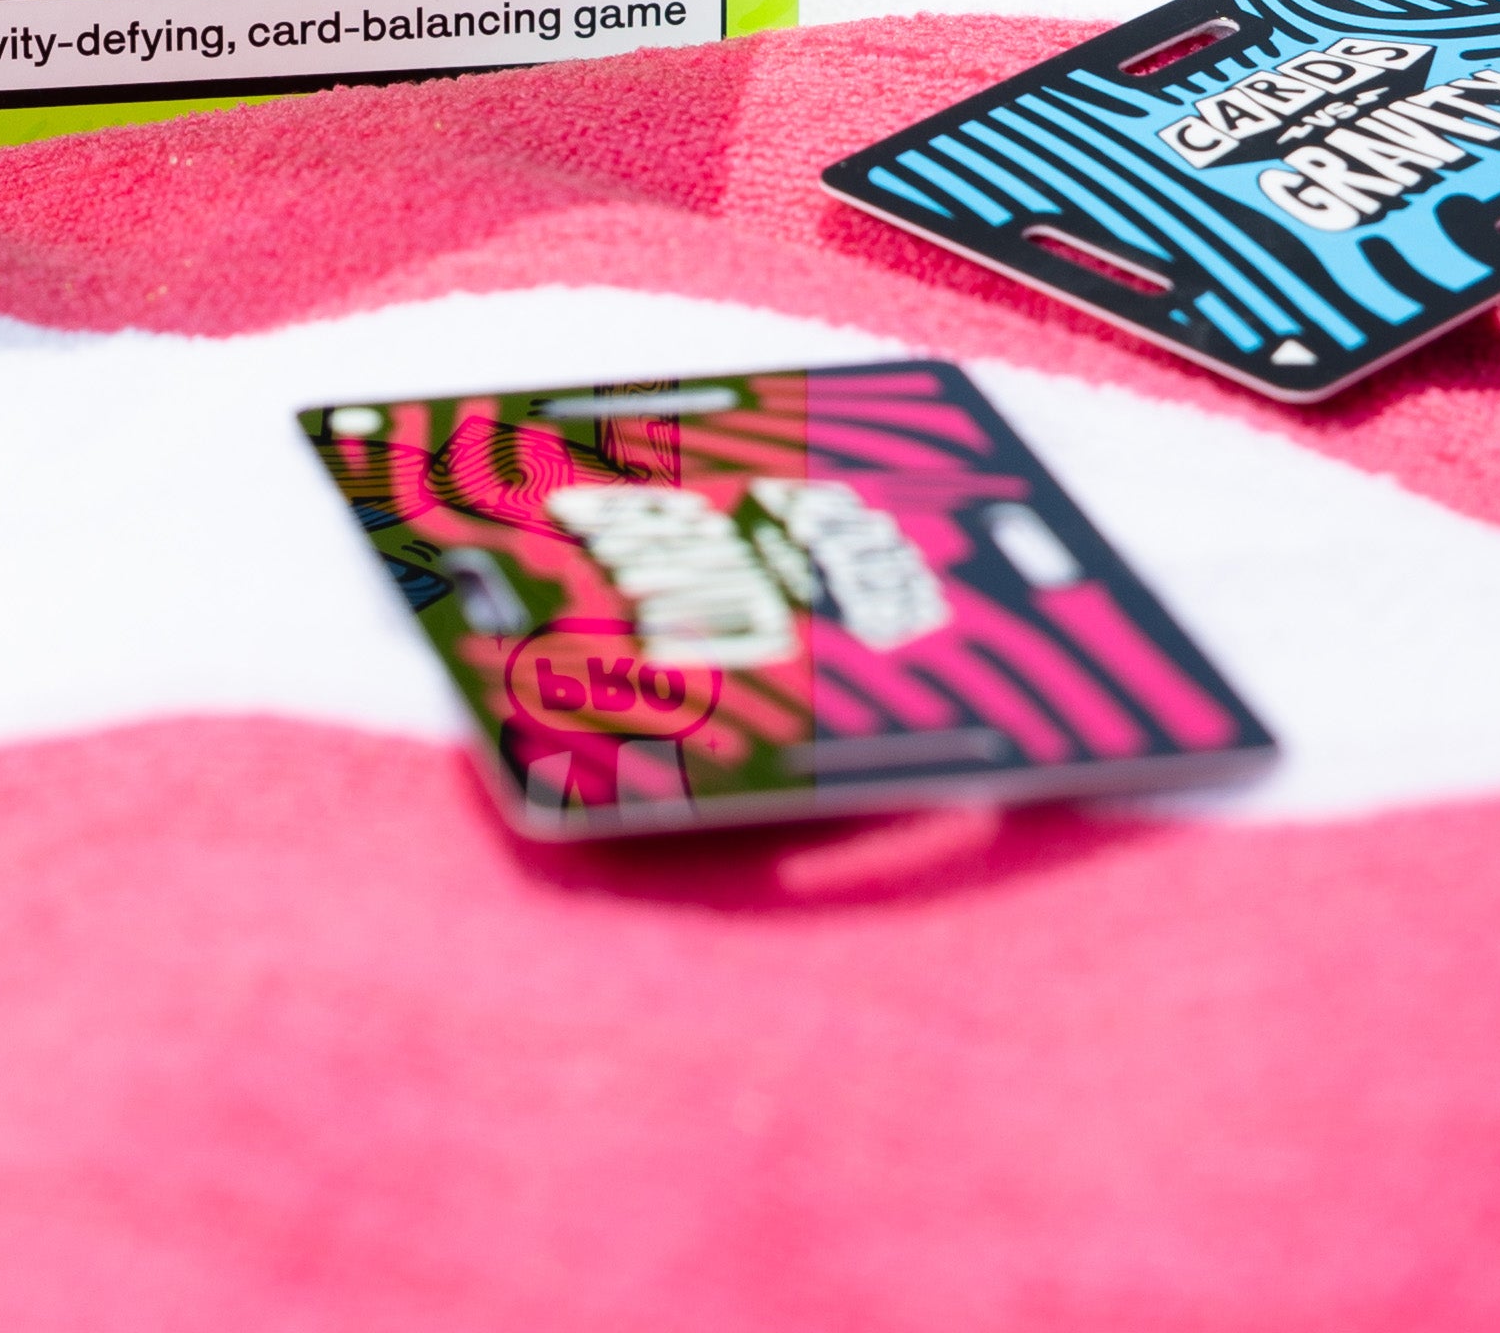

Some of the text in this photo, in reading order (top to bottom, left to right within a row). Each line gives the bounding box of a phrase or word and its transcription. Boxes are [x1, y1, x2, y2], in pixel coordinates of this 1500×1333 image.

[247, 0, 561, 49] card-balancing
[1174, 43, 1411, 154] CARDS
[1302, 99, 1359, 131] VS
